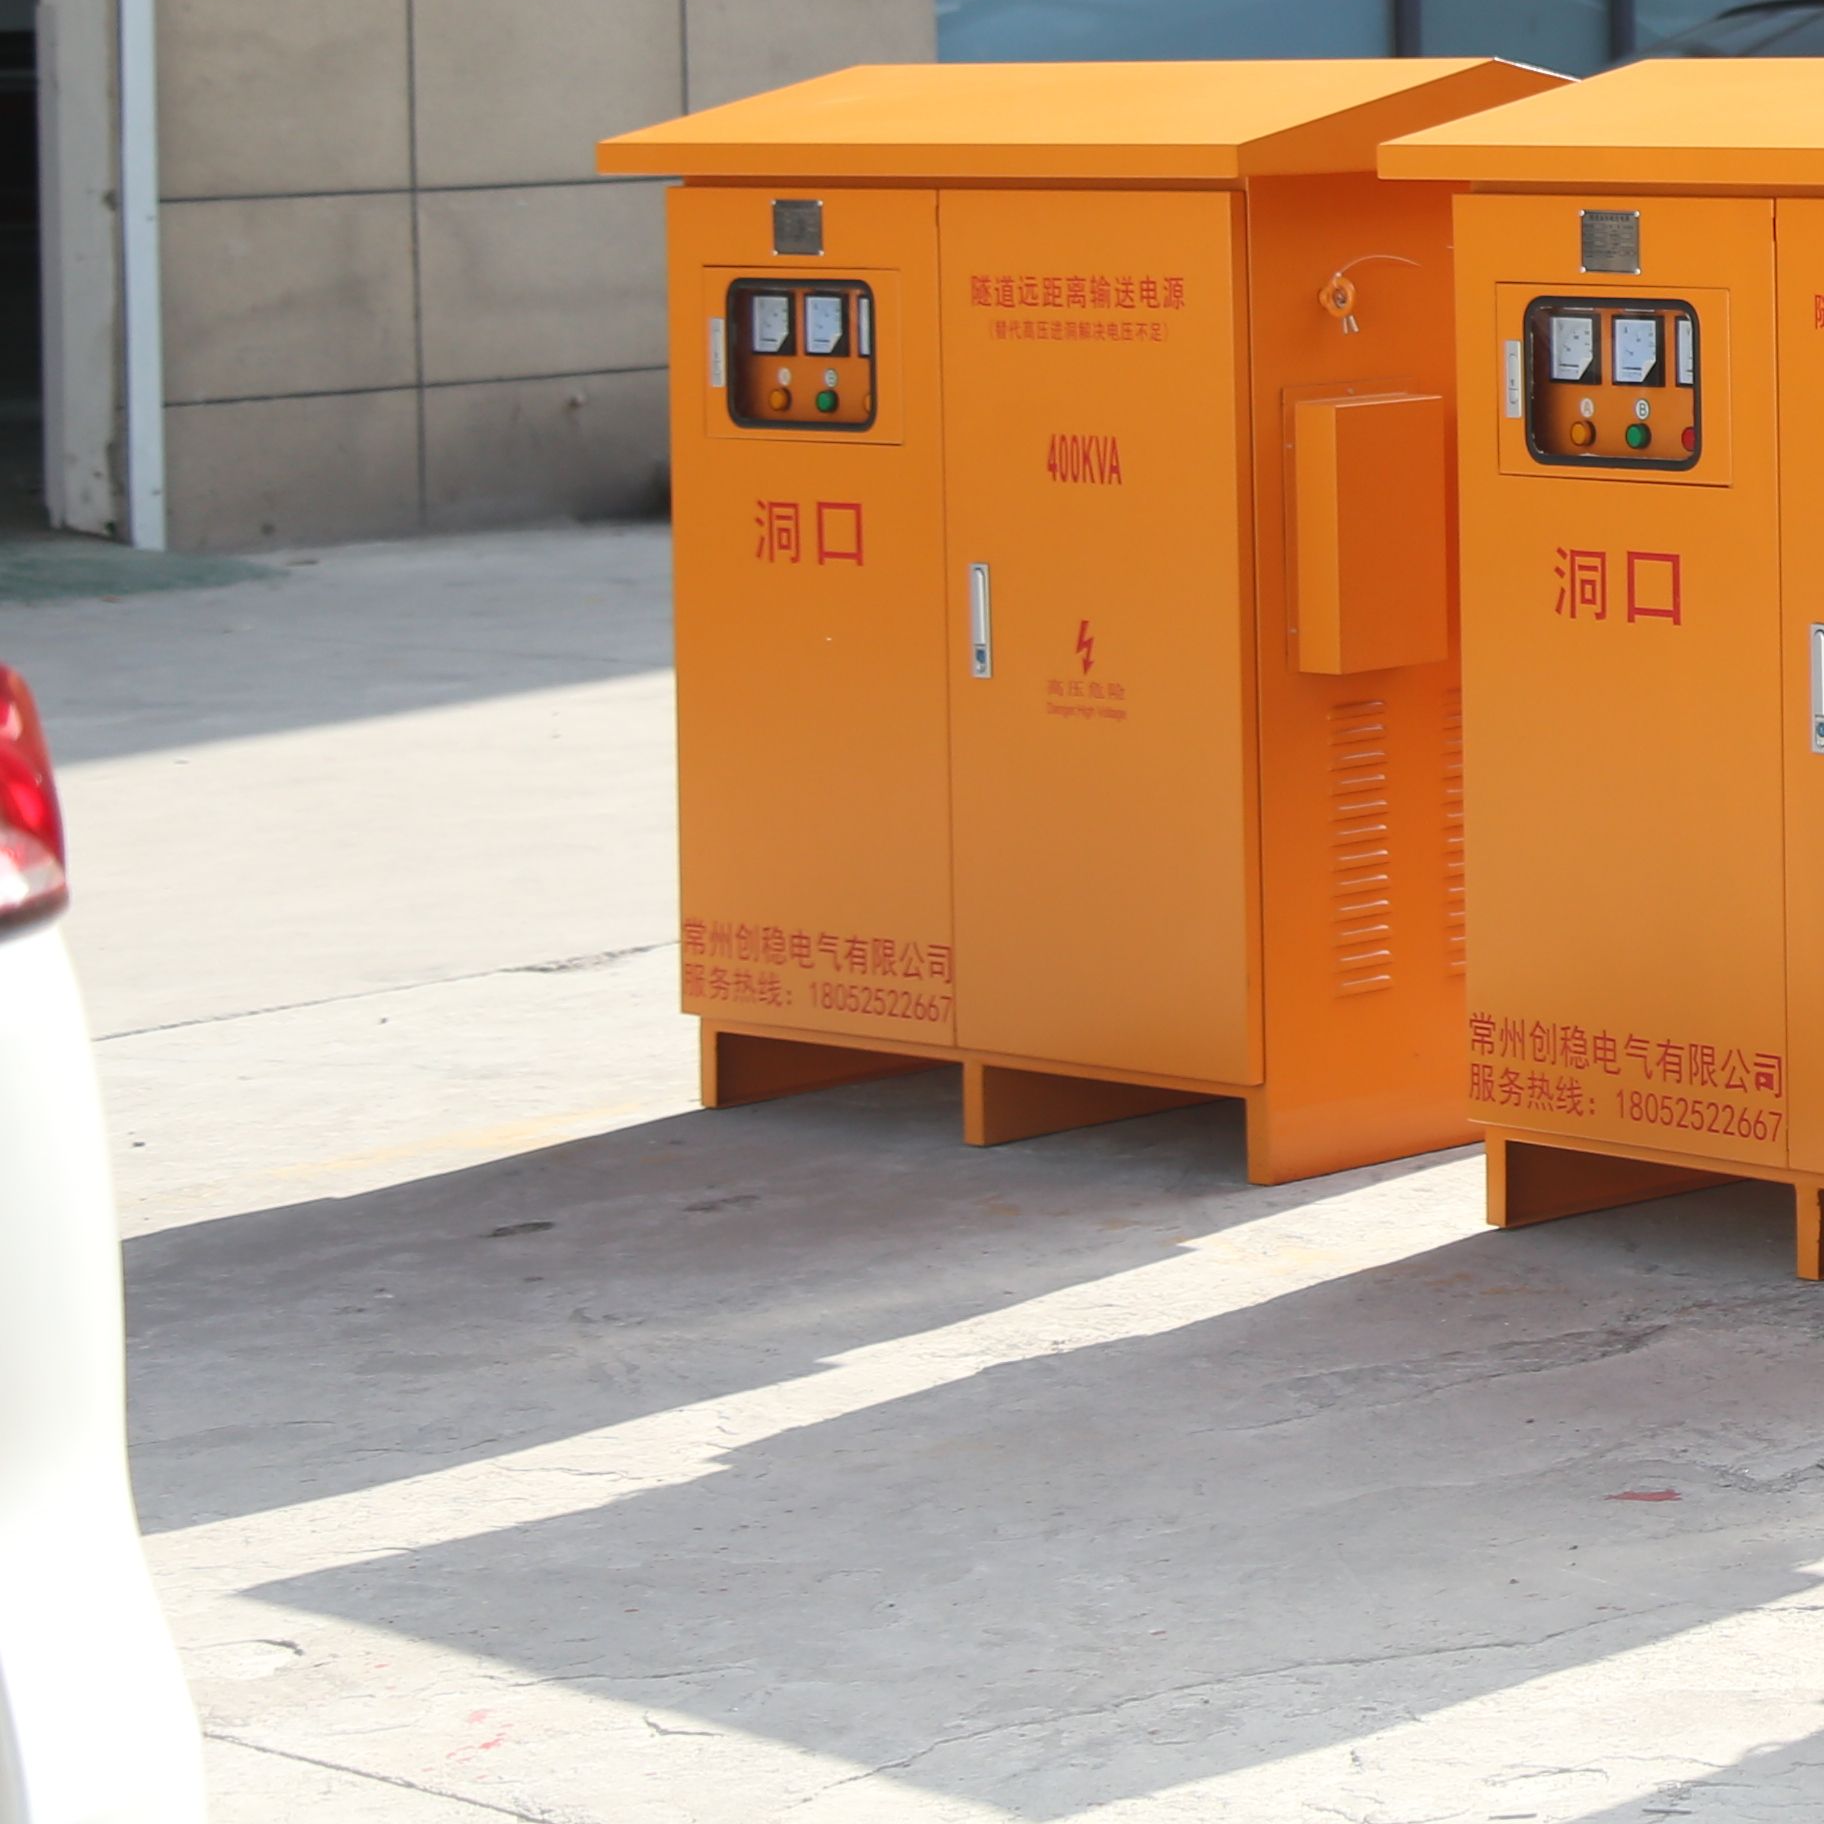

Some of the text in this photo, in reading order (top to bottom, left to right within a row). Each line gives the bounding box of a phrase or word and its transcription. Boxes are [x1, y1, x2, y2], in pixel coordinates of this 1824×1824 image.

[970, 274, 1185, 310] 隧道远距离输送电源
[1046, 433, 1123, 486] 400KVA
[754, 499, 864, 567] 洞口
[1553, 546, 1682, 626] 洞口
[684, 917, 952, 985] 常州创稳电气有限公司
[808, 981, 952, 1023] 18052522667
[1469, 1011, 1784, 1099] 常州创稳电气有限公司
[1616, 1087, 1783, 1143] 18052522667
